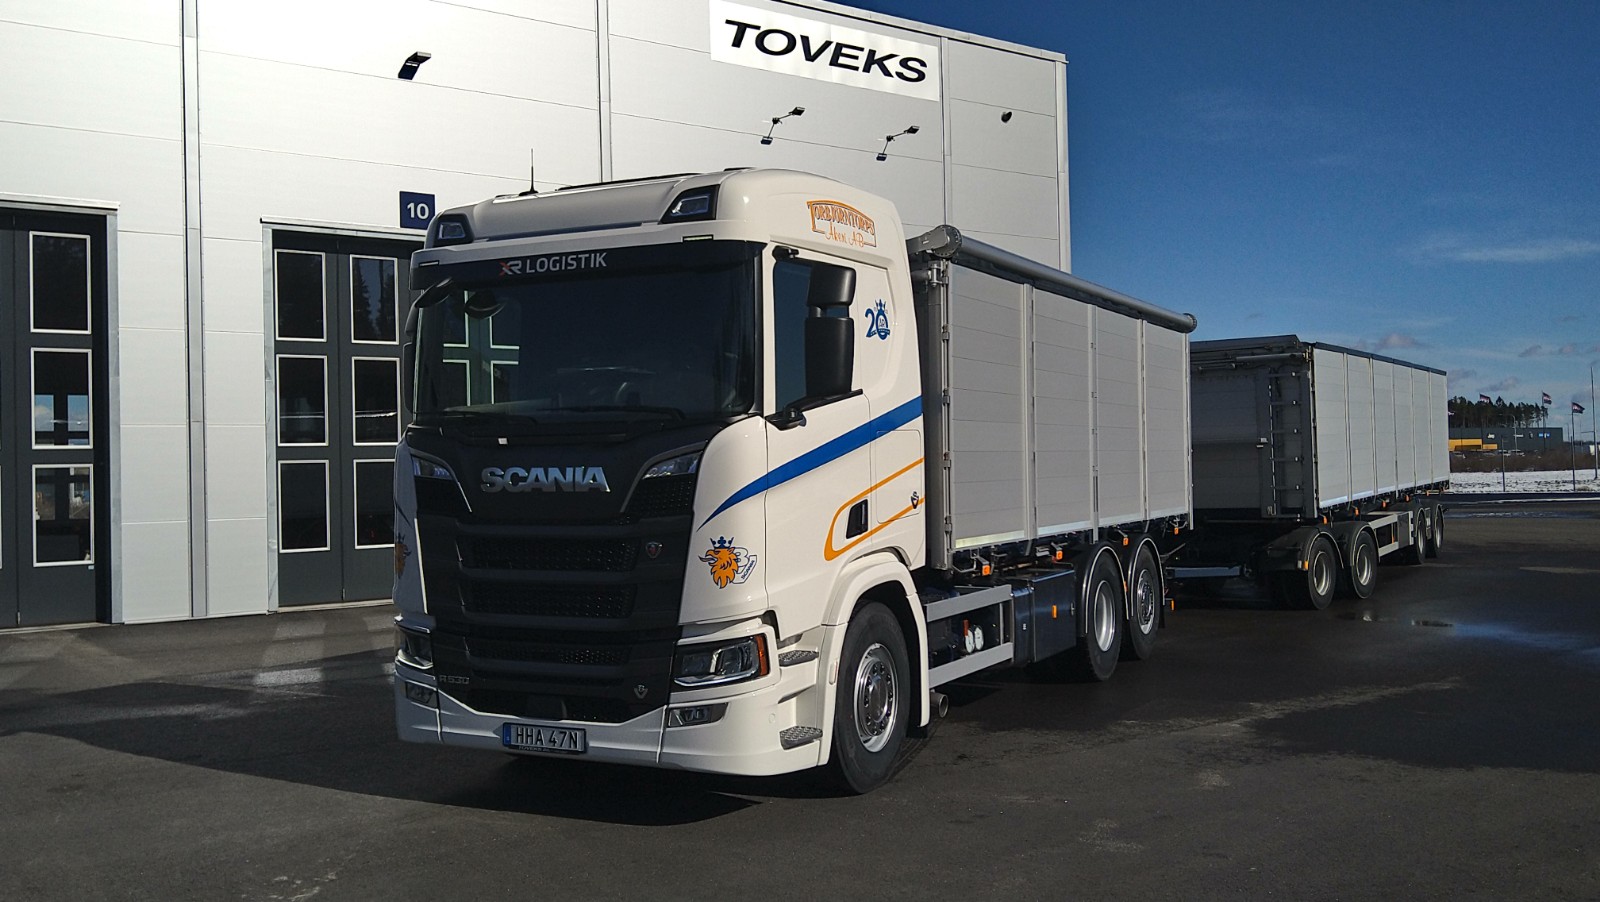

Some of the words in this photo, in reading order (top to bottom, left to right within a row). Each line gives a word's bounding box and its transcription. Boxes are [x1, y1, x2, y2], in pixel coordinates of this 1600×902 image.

[725, 19, 928, 83] TOVEKS
[407, 202, 430, 220] 10
[526, 252, 608, 274] LOGISTIK
[481, 466, 611, 493] SCANIA
[516, 727, 545, 747] HHA
[549, 730, 578, 749] 47N
